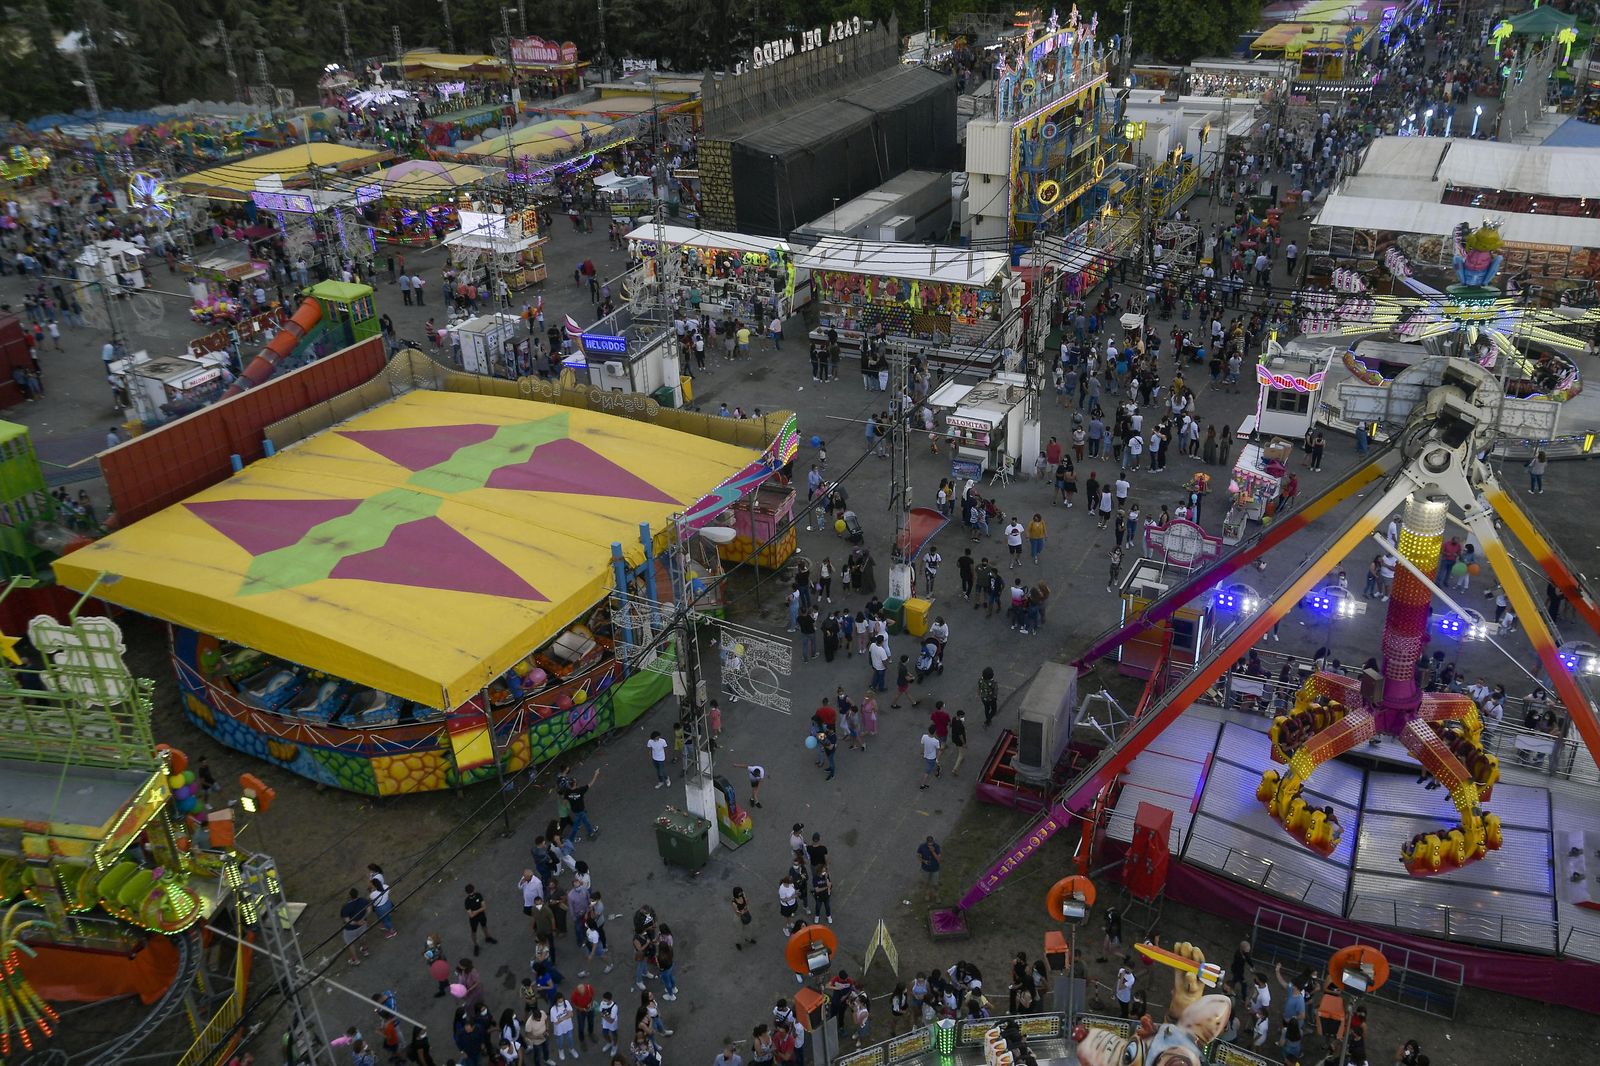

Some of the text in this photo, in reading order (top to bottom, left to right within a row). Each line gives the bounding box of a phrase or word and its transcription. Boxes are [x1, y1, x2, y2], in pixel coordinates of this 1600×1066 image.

[585, 338, 627, 352] HELADOS
[946, 417, 989, 430] PALOMITAS
[998, 820, 1057, 876] PROJEKT
